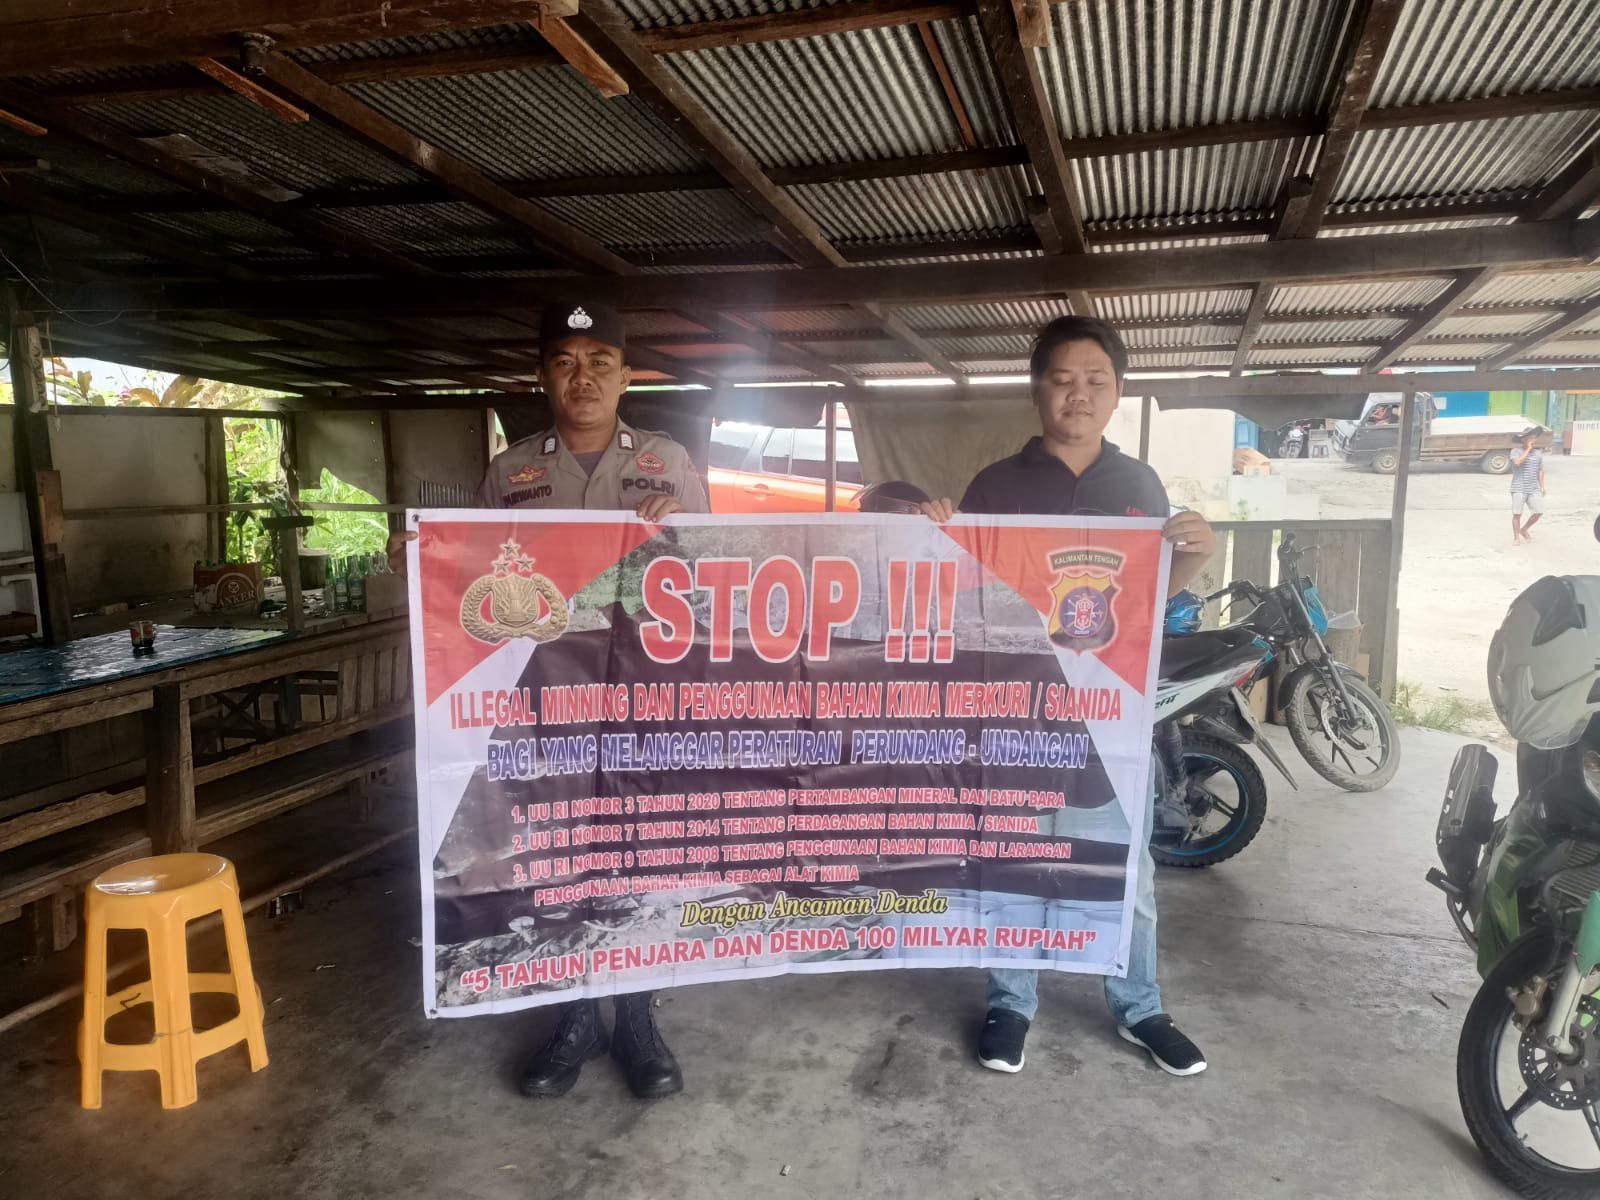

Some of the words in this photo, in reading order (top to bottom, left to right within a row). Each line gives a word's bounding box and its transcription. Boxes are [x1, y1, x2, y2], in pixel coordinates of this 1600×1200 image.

[622, 478, 676, 496] POLRI
[1054, 553, 1093, 564] KALIMANTAN
[1094, 556, 1119, 566] TENGAH
[217, 590, 256, 607] ANKER
[639, 555, 862, 664] STOP
[885, 560, 958, 663] !!!
[450, 688, 537, 730] ILLEGAL
[541, 684, 628, 725] MINNING
[634, 683, 675, 722] DAN
[679, 681, 812, 720] PENGGUNAAN
[816, 681, 882, 719] BAHAN
[886, 681, 940, 718] KIMIA
[945, 682, 1030, 719] MERKURI
[1033, 683, 1043, 719] /
[1044, 684, 1121, 721] SIANIDA
[487, 738, 537, 781] BAGI
[540, 735, 598, 776] YANG
[600, 732, 724, 773] MELANGGAR
[728, 729, 842, 768] PERATURAN
[851, 729, 966, 765] PERUNDANG
[968, 744, 976, 757] -
[980, 730, 1089, 769] UNDANGAN
[511, 805, 526, 823] 1.
[528, 803, 550, 822] UU
[553, 801, 569, 820] RI
[572, 796, 622, 818] NOMOR
[624, 797, 634, 813] 3
[638, 794, 685, 813] TAHUN
[687, 792, 720, 811] 2020
[722, 790, 785, 809] TENTANG
[788, 787, 896, 806] PERTAMBANGAN
[898, 787, 957, 804] MINERAL
[959, 788, 986, 806] DAN
[989, 789, 1025, 807] BATU
[1028, 790, 1066, 809] BARA
[511, 834, 527, 852] 2.
[529, 831, 551, 850] UU
[553, 829, 569, 848] RI
[572, 824, 622, 846] NOMOR
[624, 824, 634, 841] 7
[638, 821, 685, 841] TAHUN
[687, 819, 720, 838] 2014
[722, 816, 785, 837] TENTANG
[787, 813, 886, 832] PERDAGANGAN
[888, 812, 934, 831] BAHAN
[936, 812, 976, 830] KIMIA
[977, 815, 983, 831] /
[984, 814, 1038, 834] SIANIDA
[512, 864, 528, 882] 3.
[529, 861, 552, 880] UU
[554, 859, 570, 877] RI
[572, 853, 622, 875] NOMOR
[624, 853, 634, 869] 9
[638, 850, 685, 869] TAHUN
[686, 847, 720, 866] 2008
[722, 844, 784, 863] TENTANG
[786, 839, 877, 858] PENGGUNAAN
[880, 838, 926, 856] BAHAN
[928, 838, 967, 856] KIMIA
[969, 840, 997, 858] DAN
[999, 841, 1072, 859] LARANGAN
[534, 880, 629, 907] PENGGUNAAN
[632, 873, 679, 894] BAHAN
[681, 870, 722, 890] KIMIA
[724, 865, 782, 885] SEBAGAI
[784, 865, 819, 883] ALAT
[820, 864, 860, 882] KIMIA
[680, 899, 767, 929] Dengan
[769, 891, 876, 919] Ancaman
[876, 889, 950, 915] Denda
[497, 952, 587, 990] TAHUN
[591, 938, 706, 973] PENJARA
[713, 933, 763, 959] DAN
[769, 927, 848, 954] DENDA
[855, 926, 897, 948] 100
[903, 926, 988, 948] MILYAR
